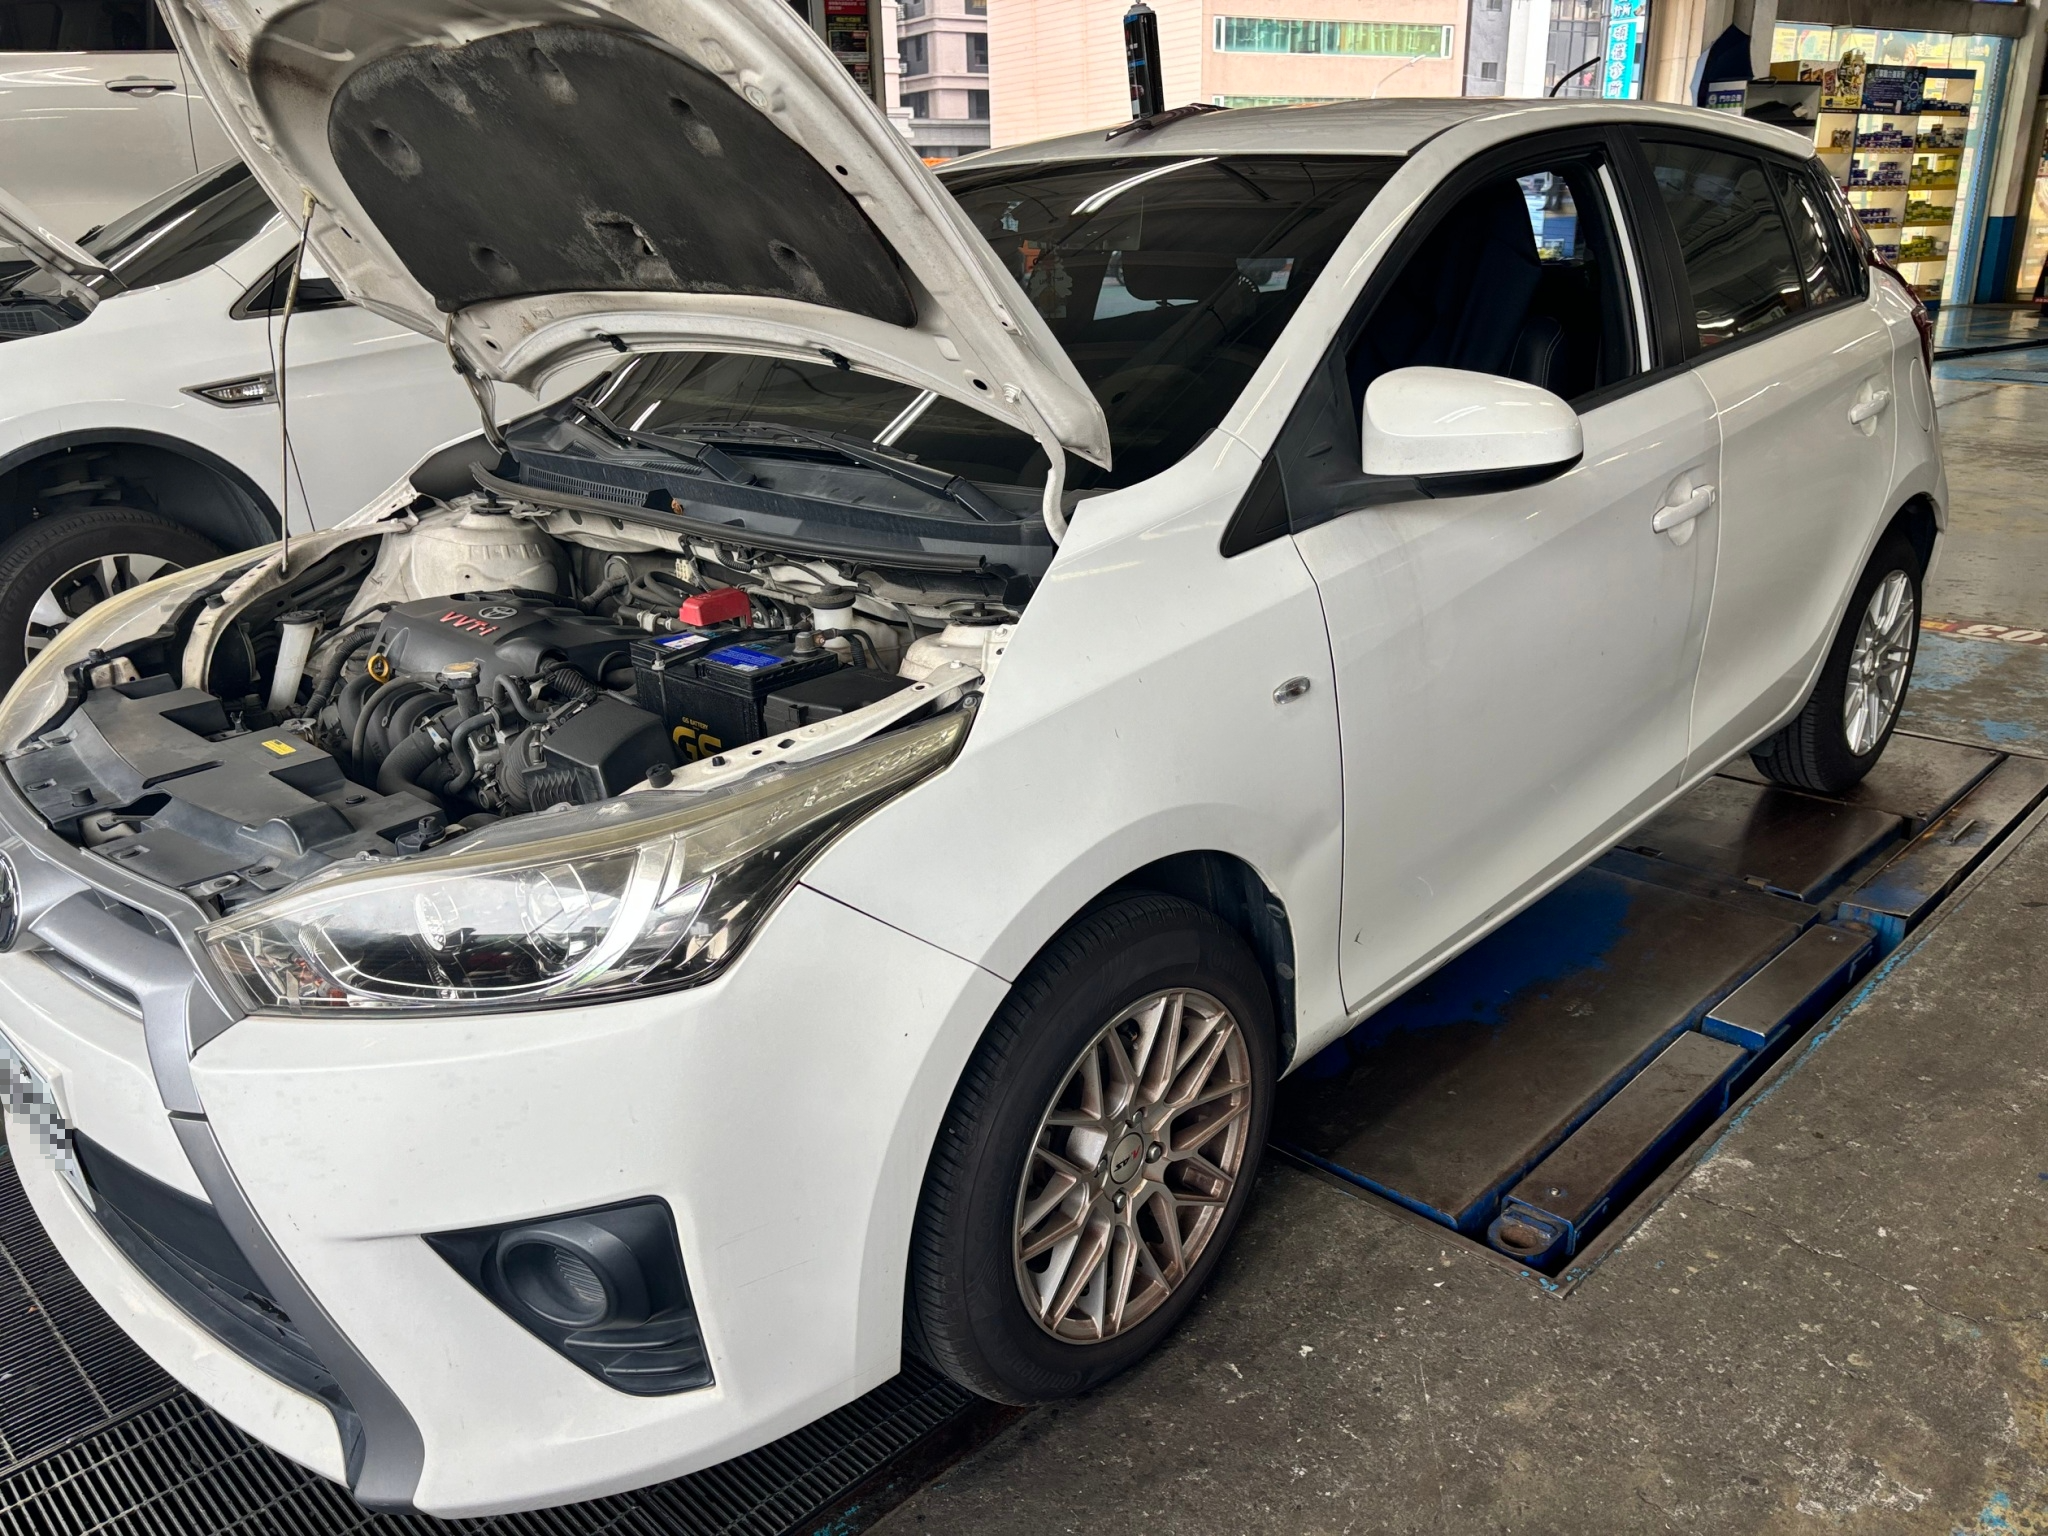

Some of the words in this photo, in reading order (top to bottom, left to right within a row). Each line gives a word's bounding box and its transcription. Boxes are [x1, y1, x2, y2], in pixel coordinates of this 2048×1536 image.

[439, 611, 498, 637] VVT-i
[682, 716, 690, 724] GS
[689, 718, 709, 731] BATTERY
[672, 725, 722, 762] GS
